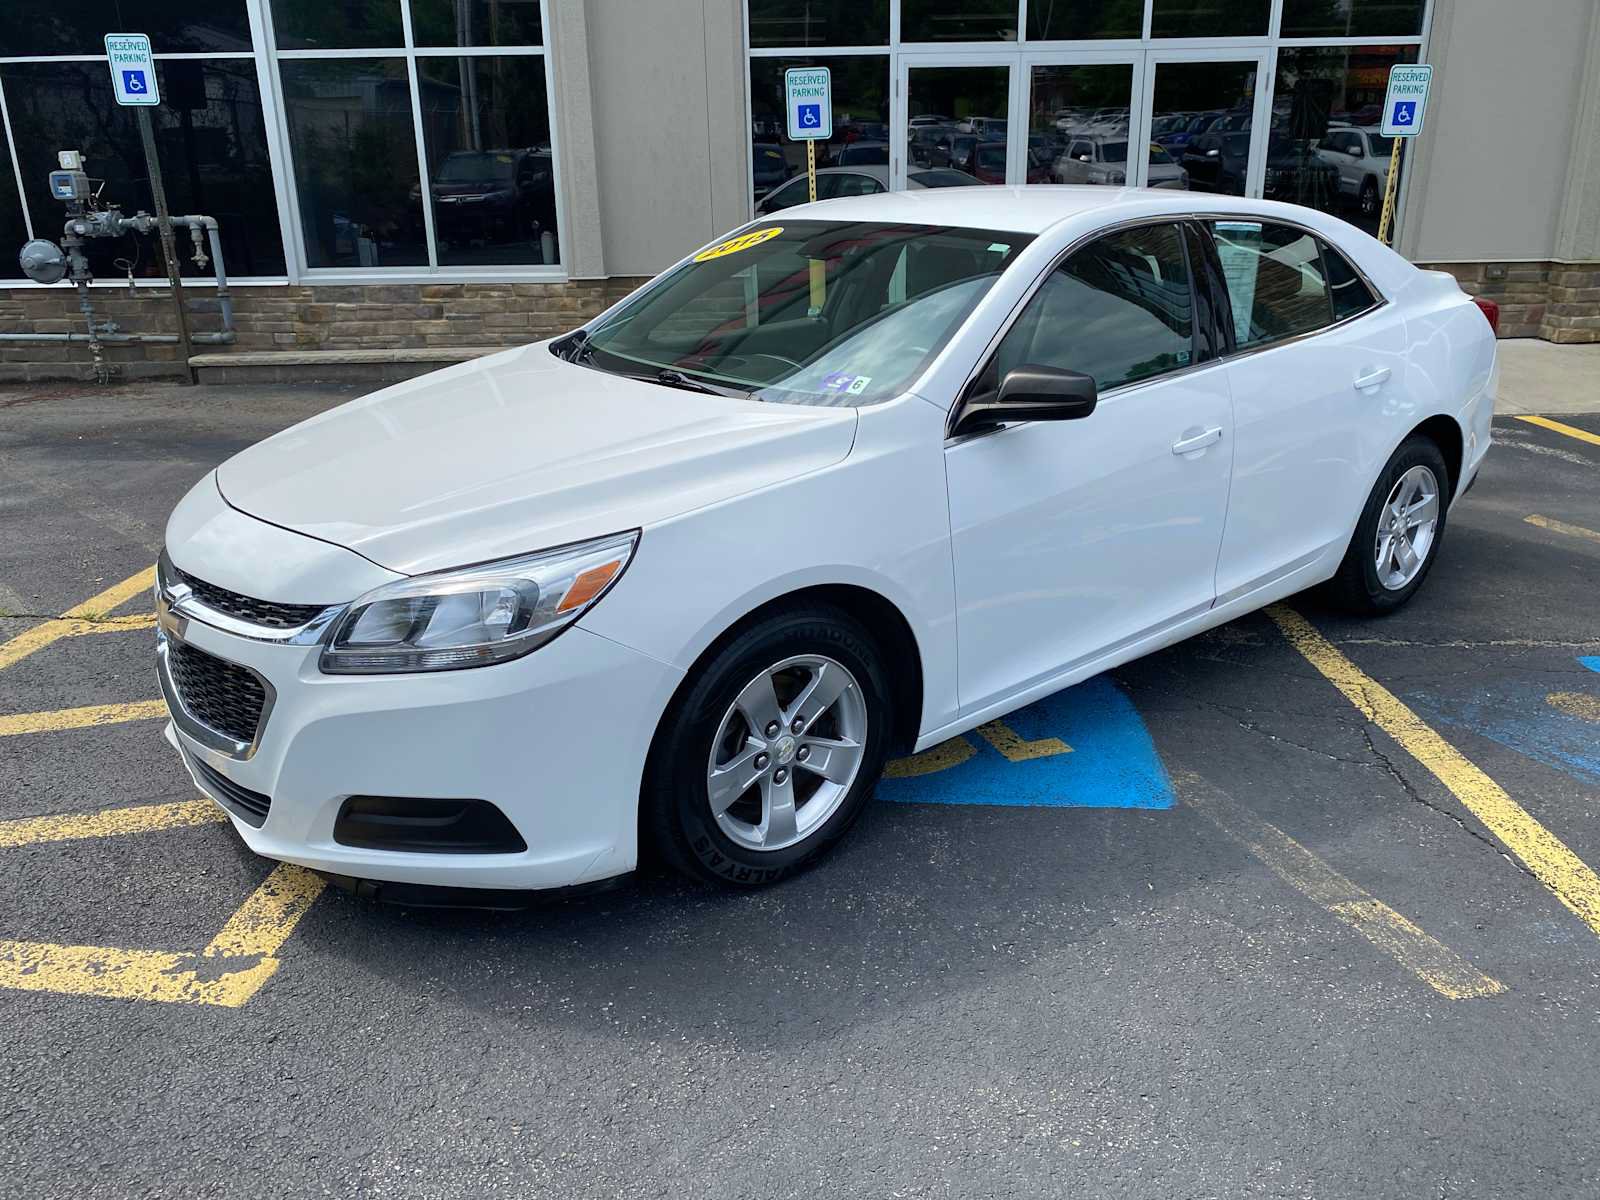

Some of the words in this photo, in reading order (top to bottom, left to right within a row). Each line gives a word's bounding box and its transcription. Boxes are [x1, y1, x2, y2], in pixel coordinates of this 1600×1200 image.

[109, 41, 147, 51] RESERVED
[114, 54, 147, 63] PARKING
[789, 75, 827, 86] RESERVED
[1392, 72, 1429, 82] RESERVED
[792, 87, 825, 97] PARKING
[1392, 84, 1424, 95] PARKING
[701, 230, 777, 258] 2015
[852, 379, 864, 390] 6
